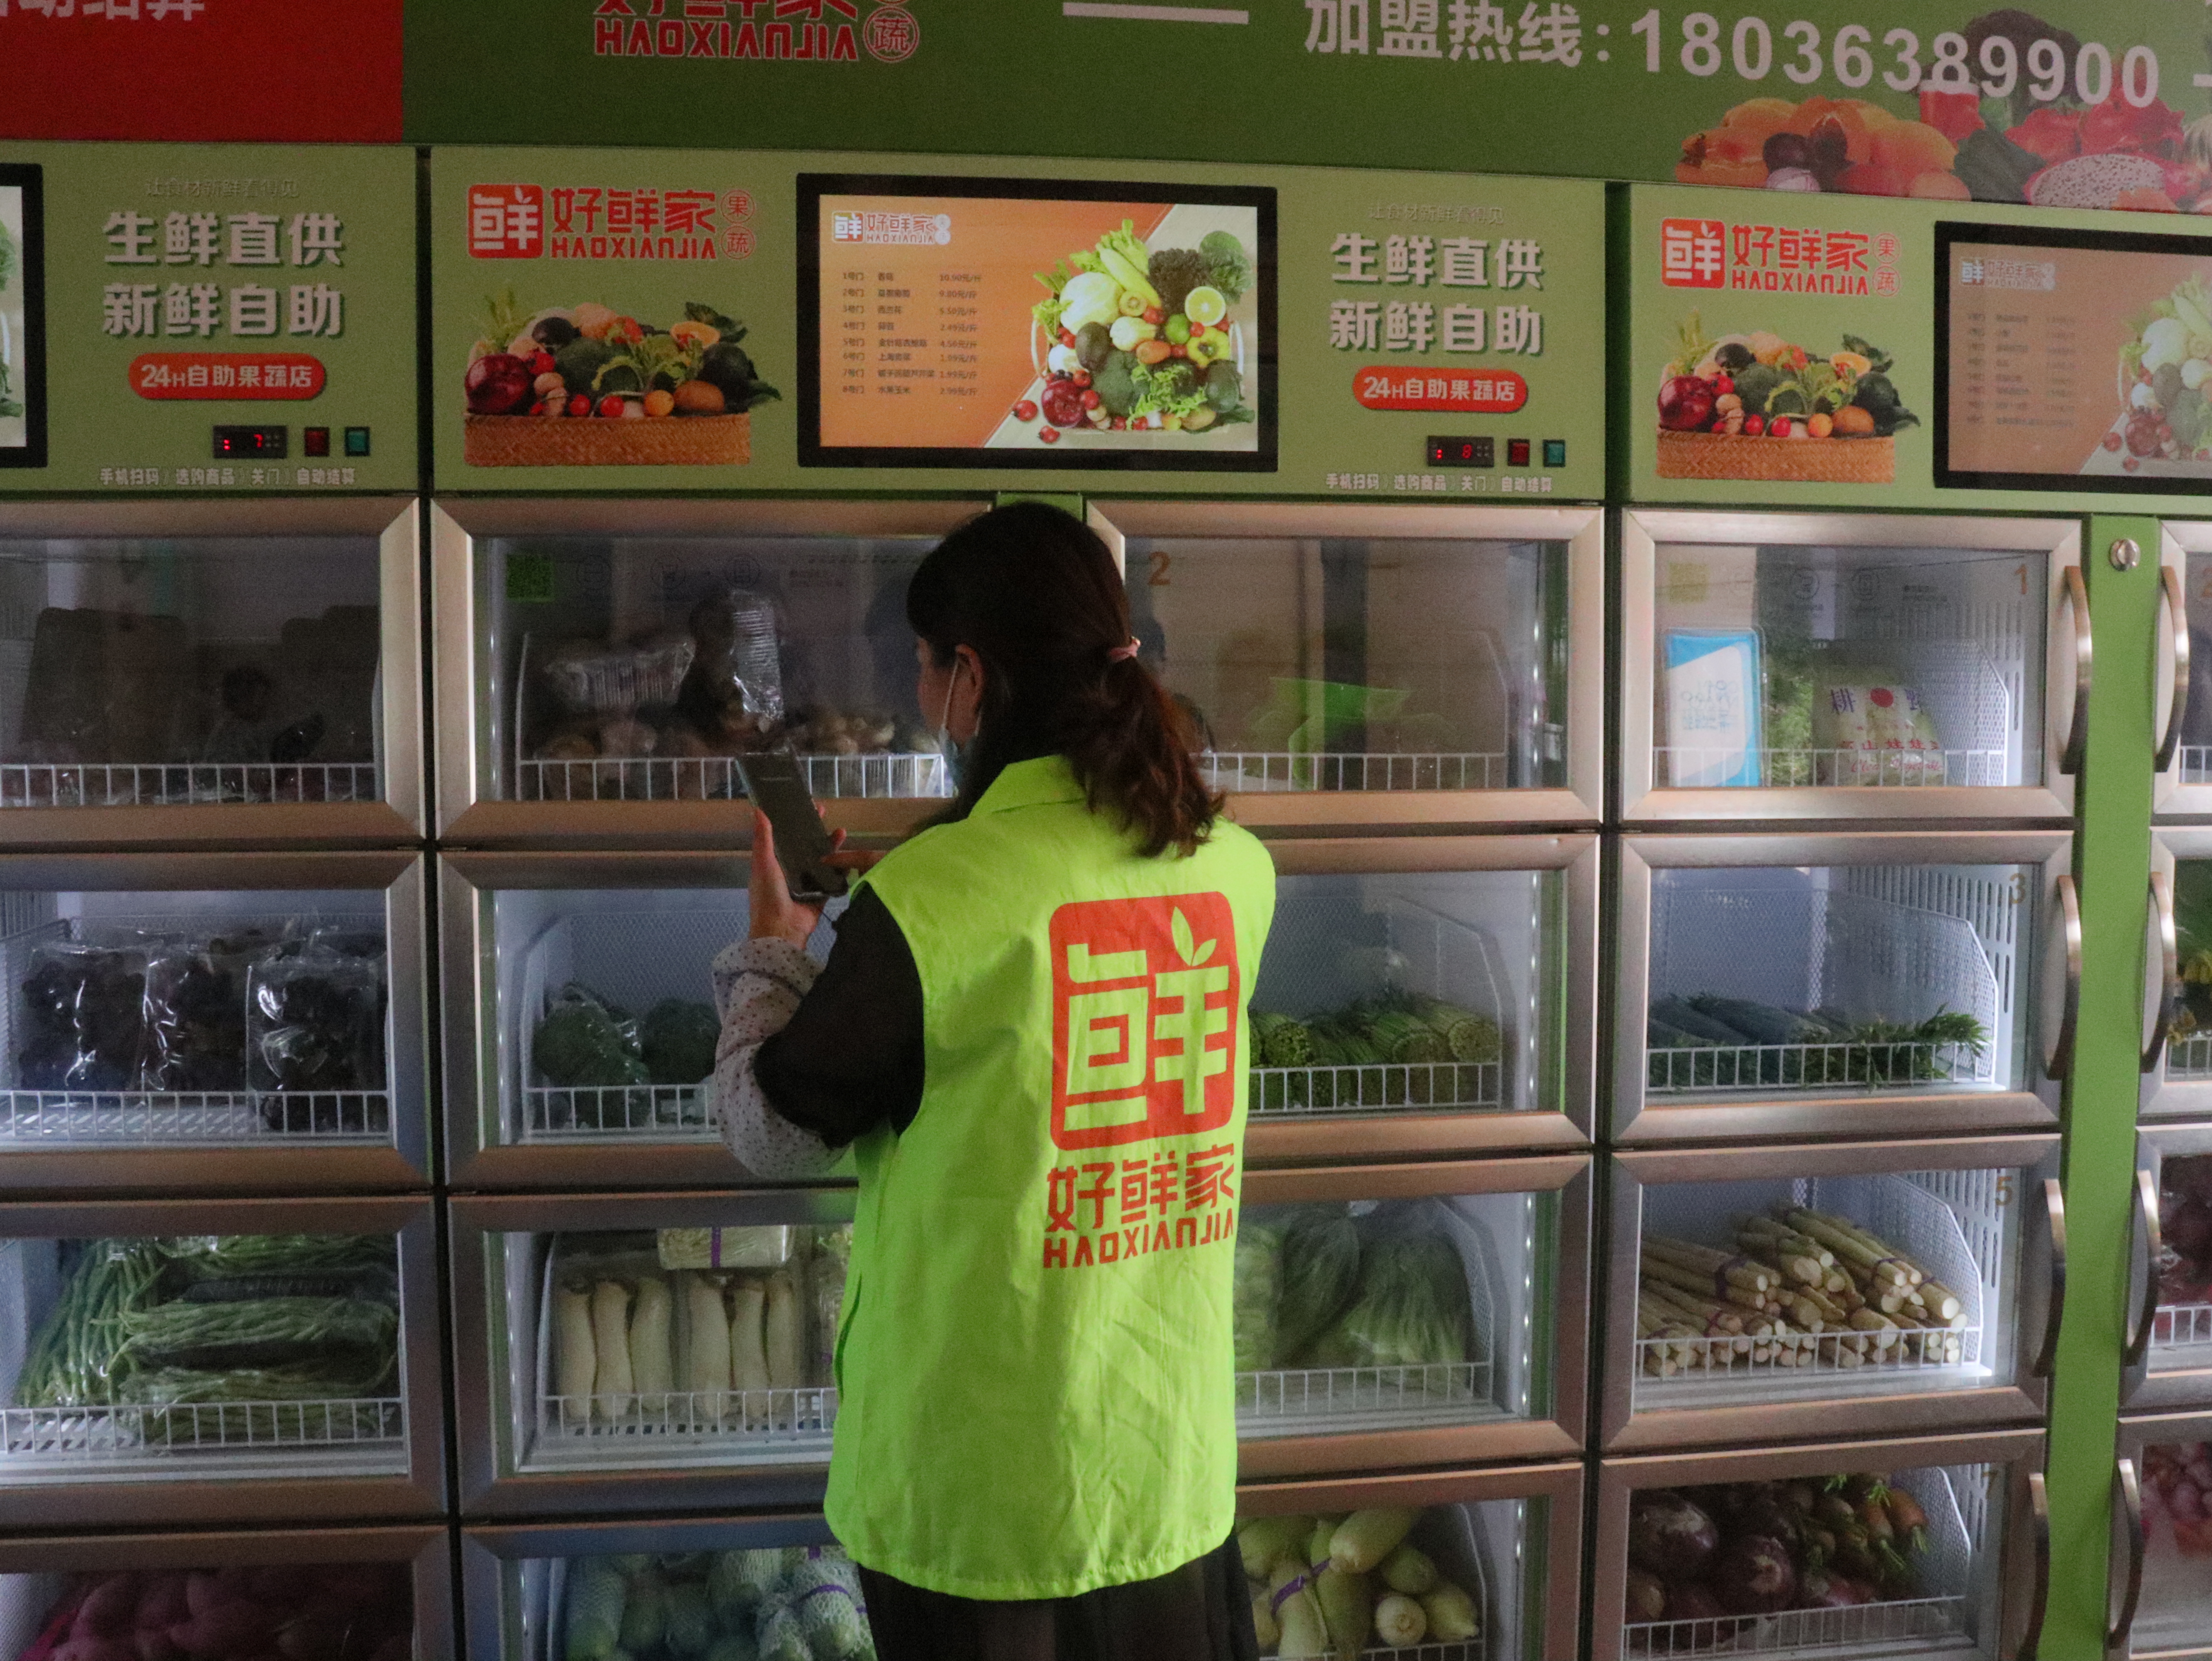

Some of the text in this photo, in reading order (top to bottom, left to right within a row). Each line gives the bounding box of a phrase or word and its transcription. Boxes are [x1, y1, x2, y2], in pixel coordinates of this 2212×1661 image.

[595, 20, 859, 61] HAOXIANJIA
[873, 18, 910, 52] 蔬
[146, 178, 299, 198] 让食材新鲜看得见
[551, 188, 715, 234] 好鲜家
[103, 211, 344, 266] 生鲜直供
[551, 237, 716, 259] HAOXIANJIA
[1732, 225, 1868, 271] 好鲜家
[1331, 233, 1544, 290] 生鲜直供
[1732, 270, 1868, 295] HAOXIANJIA
[103, 282, 342, 336] 新鲜自助
[1330, 300, 1544, 355] 新鲜自助
[141, 365, 312, 388] 24H自助果蔬店
[1364, 377, 1515, 402] 24H自助果蔬店
[100, 468, 355, 485] 手机扫码 选购商品 关门 自动结算
[1326, 473, 1552, 492] 手机扫码 选购商品 关门 自动结算
[1149, 551, 1170, 585] 2
[2015, 564, 2027, 594] 1
[2010, 873, 2025, 904] 3
[1046, 1143, 1233, 1232] 好鲜家
[1995, 1176, 2012, 1205] 5
[1043, 1209, 1233, 1268] HAOXIANJIA
